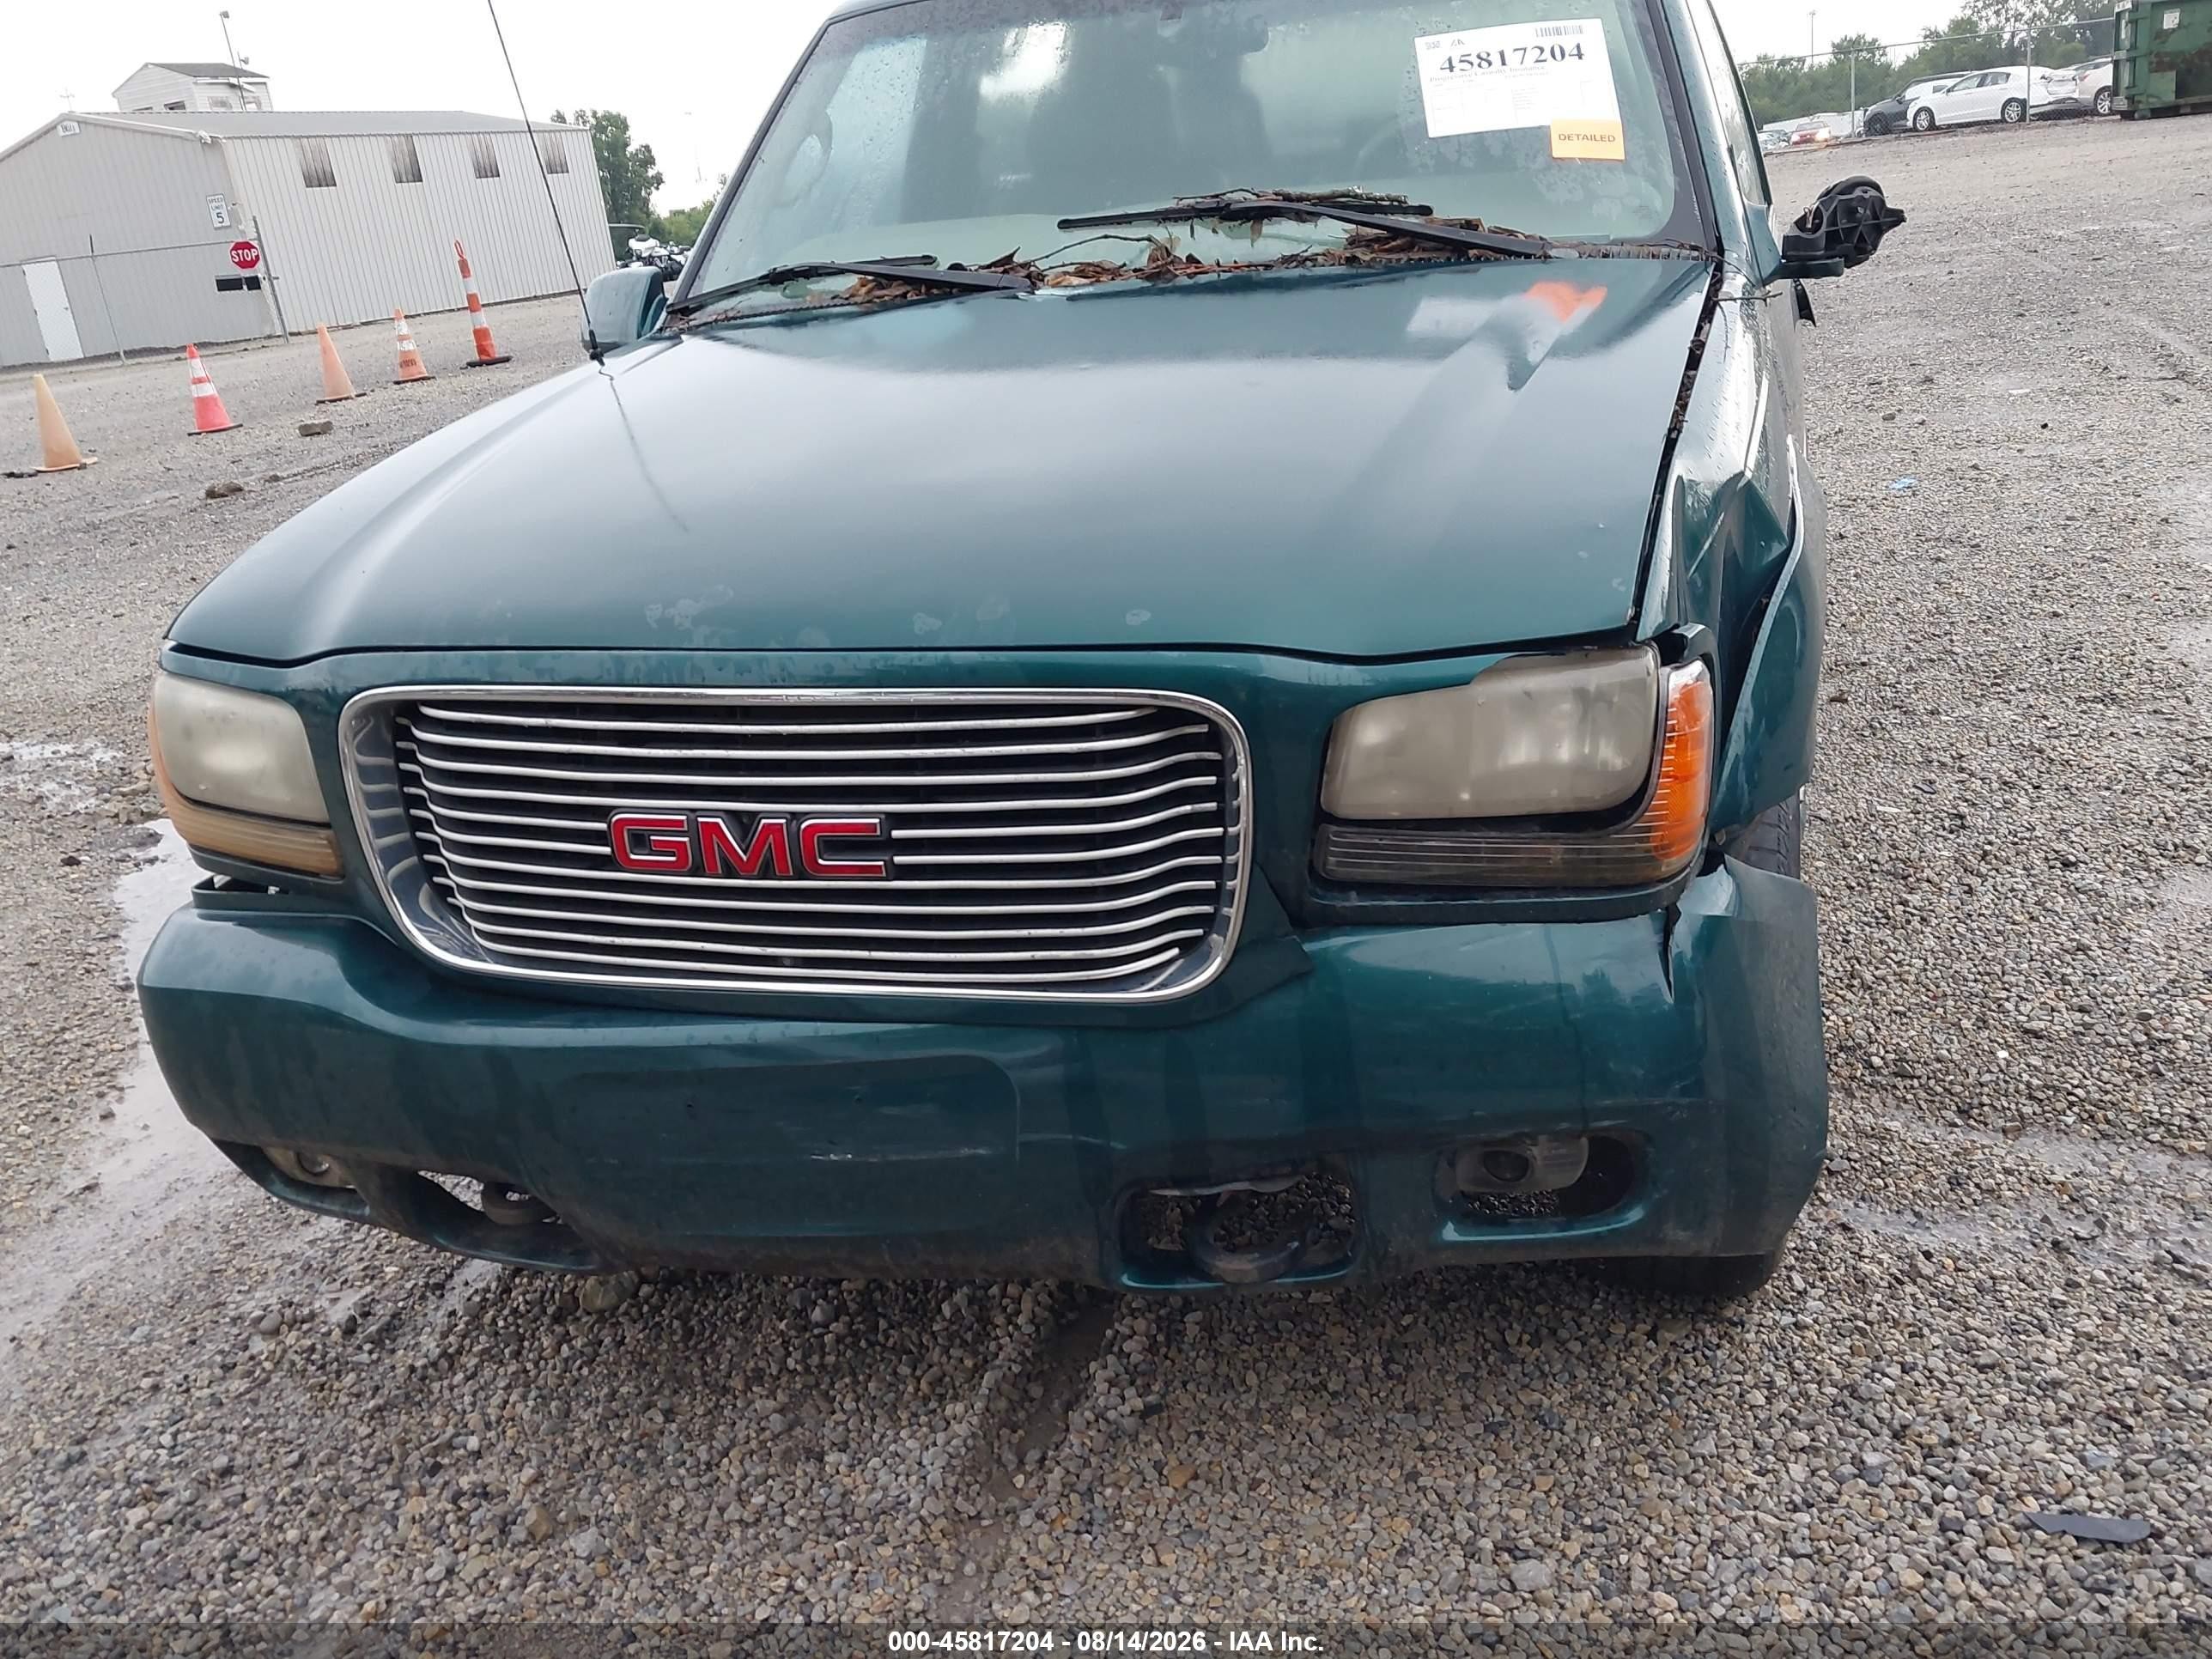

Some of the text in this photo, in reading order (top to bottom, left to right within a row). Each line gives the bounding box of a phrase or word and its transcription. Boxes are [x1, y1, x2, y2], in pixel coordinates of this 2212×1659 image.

[1440, 42, 1584, 73] 45817204
[1559, 133, 1616, 143] DETAILED
[216, 212, 224, 224] 5
[231, 249, 258, 263] STOP
[609, 811, 888, 878] GMC
